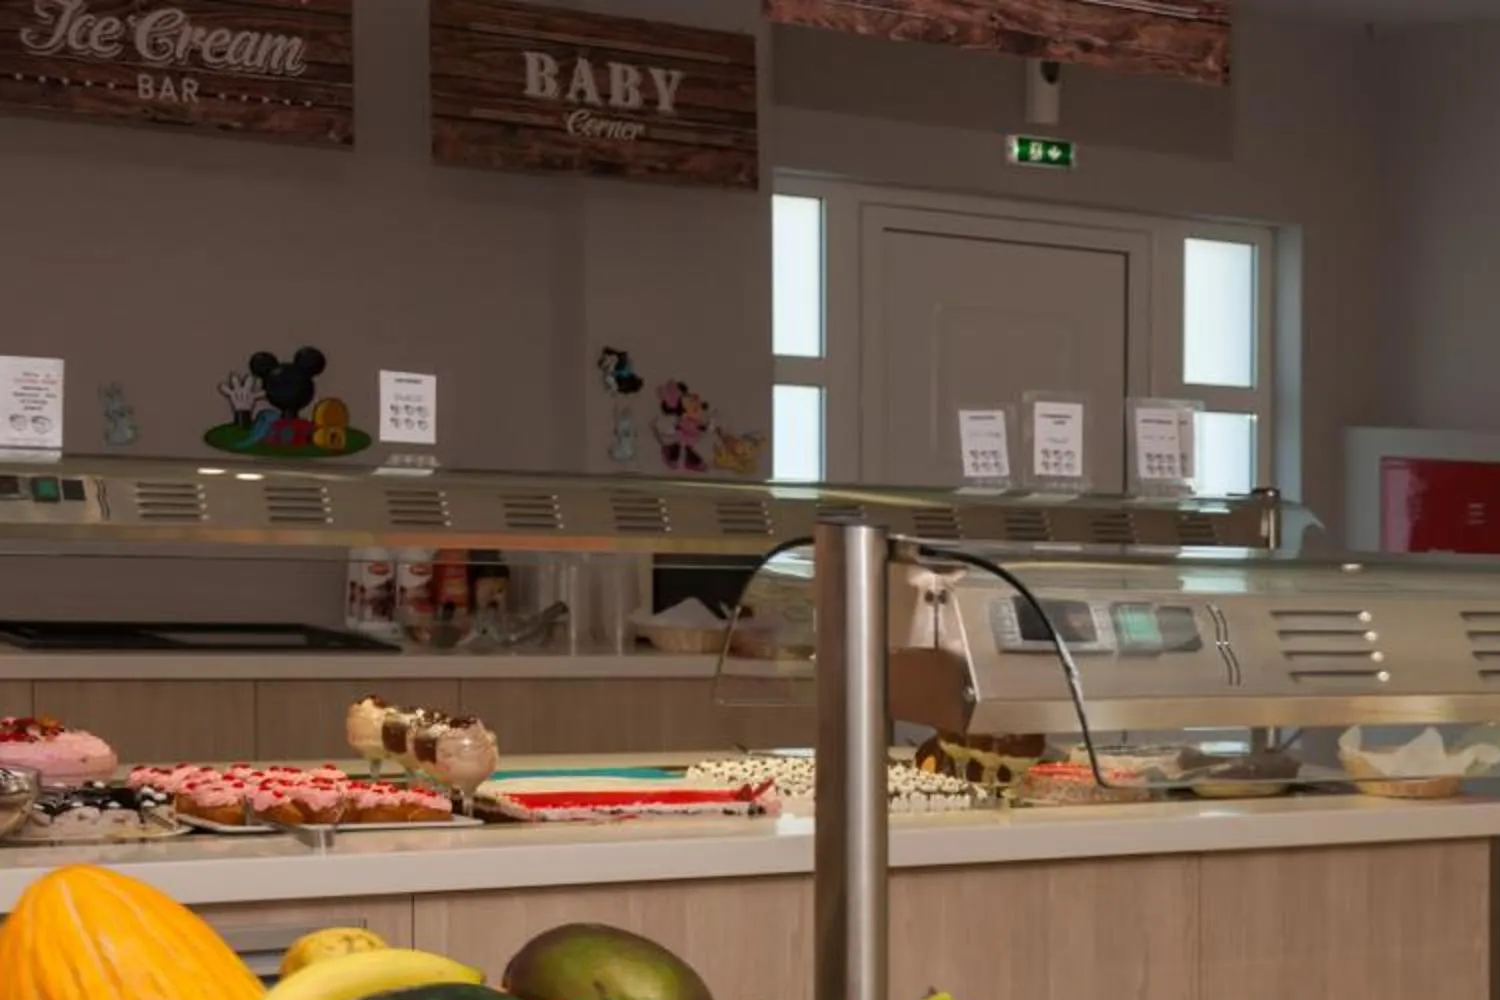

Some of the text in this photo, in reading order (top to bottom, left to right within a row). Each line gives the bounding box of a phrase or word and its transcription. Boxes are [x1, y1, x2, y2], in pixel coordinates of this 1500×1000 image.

[20, 0, 307, 77] Ice Cream
[137, 73, 200, 103] BAR
[522, 51, 686, 112] BABY
[566, 108, 645, 140] Corner
